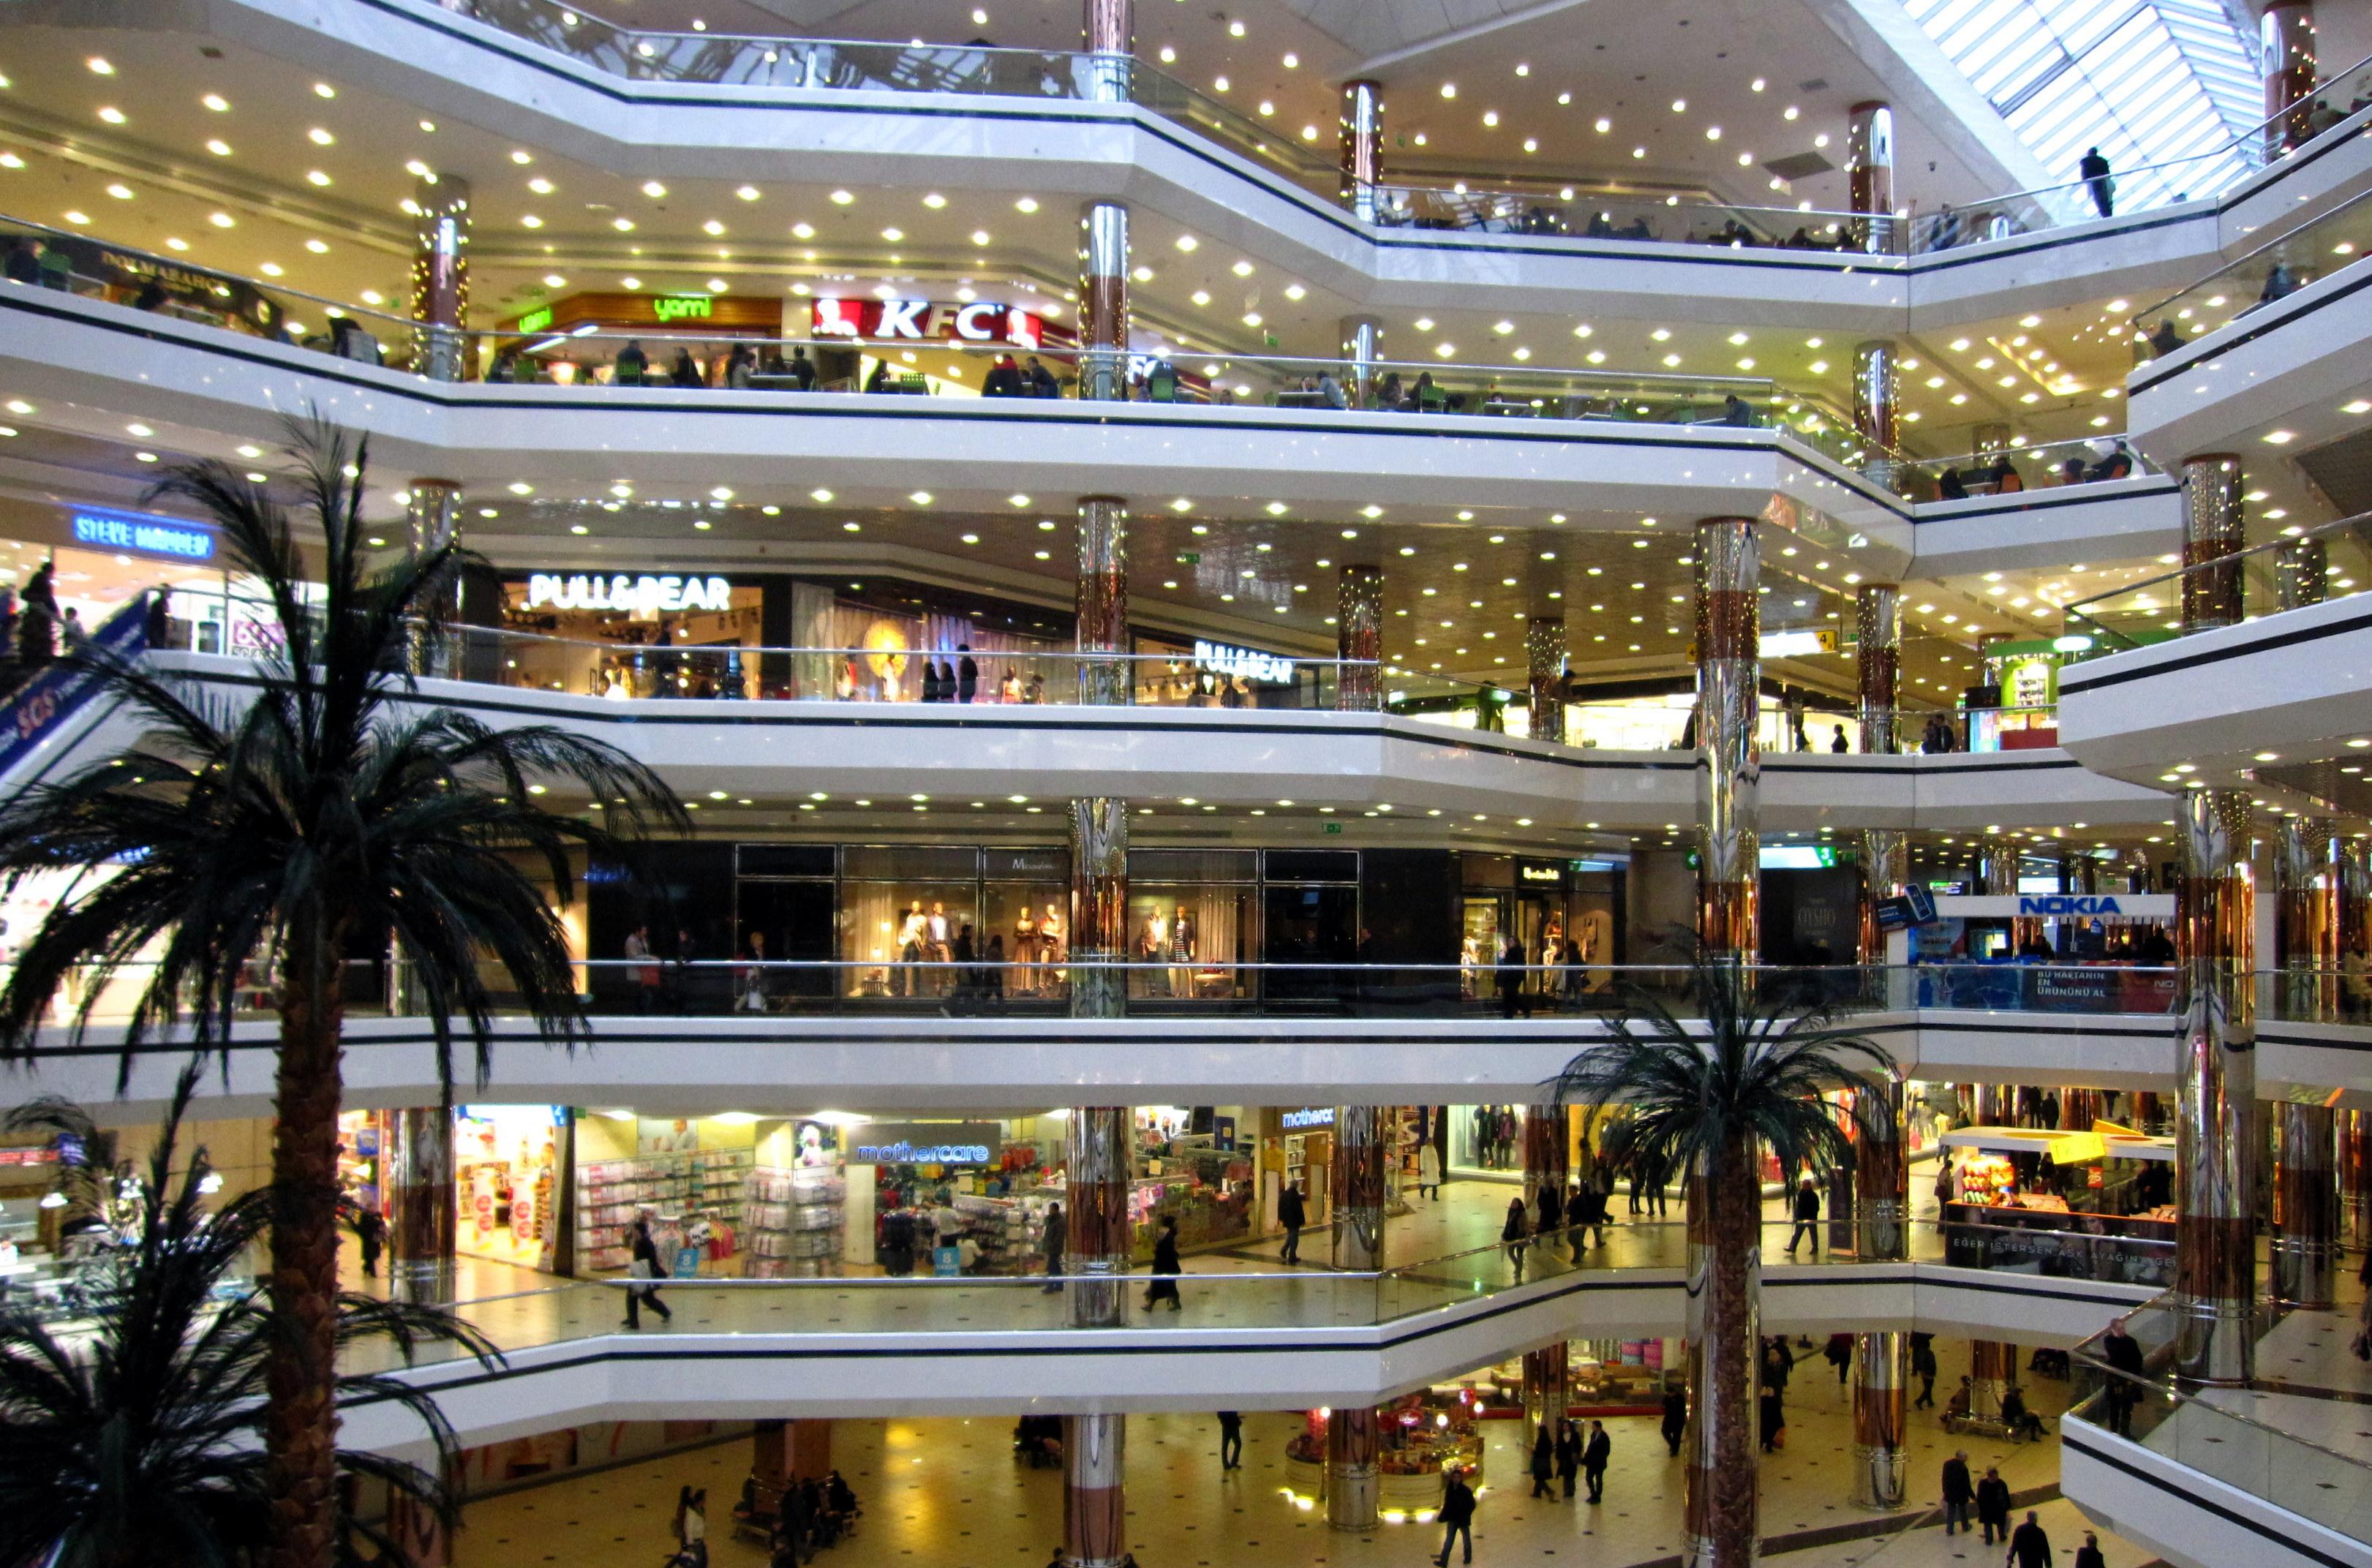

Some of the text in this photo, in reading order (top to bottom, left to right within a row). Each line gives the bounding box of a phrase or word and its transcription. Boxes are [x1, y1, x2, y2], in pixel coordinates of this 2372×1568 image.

[875, 301, 1005, 339] KFC
[76, 516, 132, 547] STEVE
[1821, 848, 1829, 859] 3
[2020, 897, 2120, 914] NOKIA
[2093, 989, 2106, 997] AL
[858, 1141, 988, 1161] mothercare
